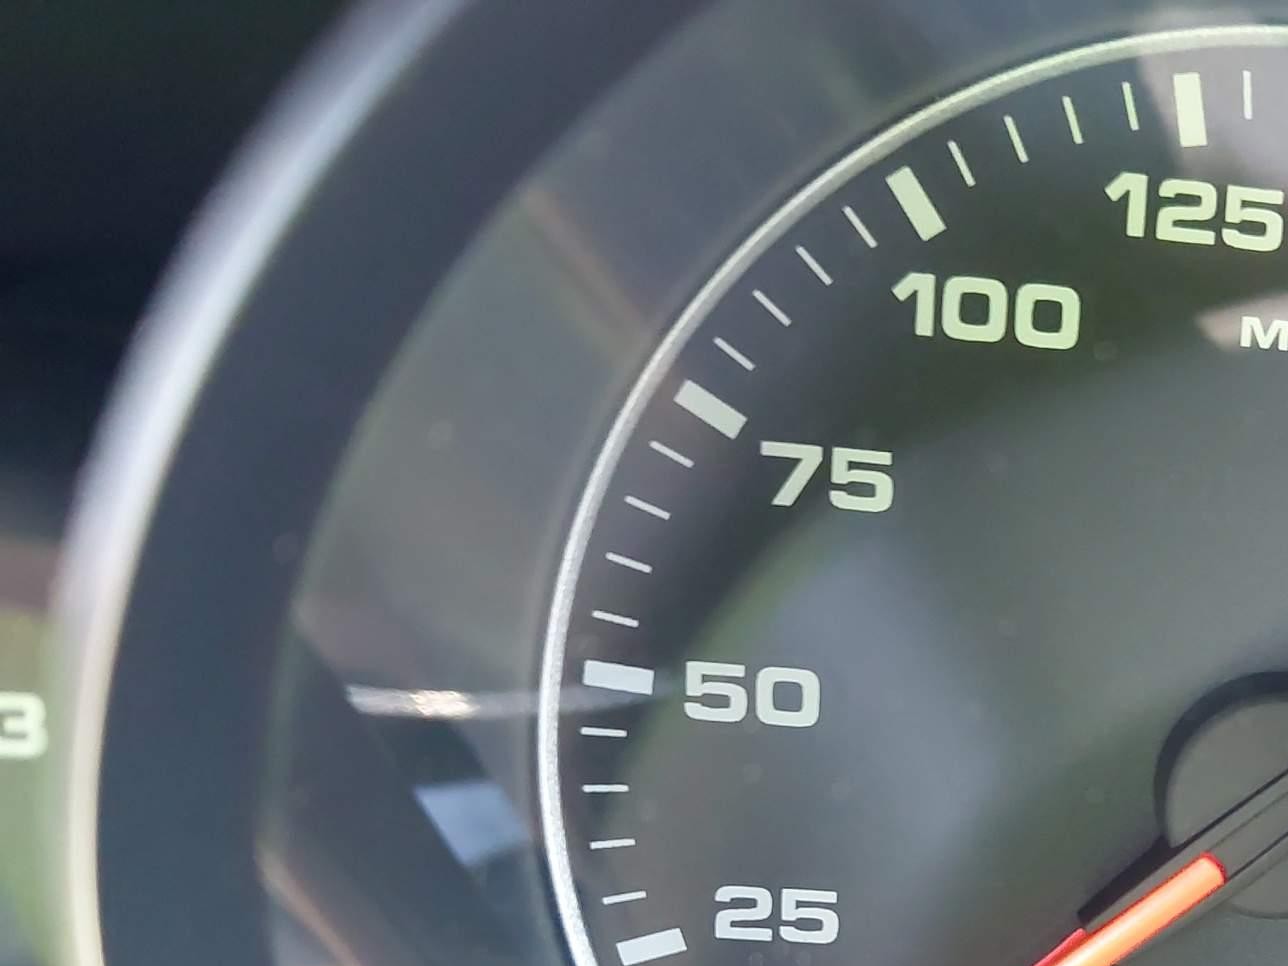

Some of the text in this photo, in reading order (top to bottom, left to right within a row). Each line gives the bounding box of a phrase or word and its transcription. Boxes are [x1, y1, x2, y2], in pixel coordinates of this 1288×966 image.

[1104, 172, 1285, 252] 125
[891, 272, 1081, 350] 100
[760, 441, 895, 513] 75
[683, 660, 821, 728] 50
[714, 885, 840, 945] 25
